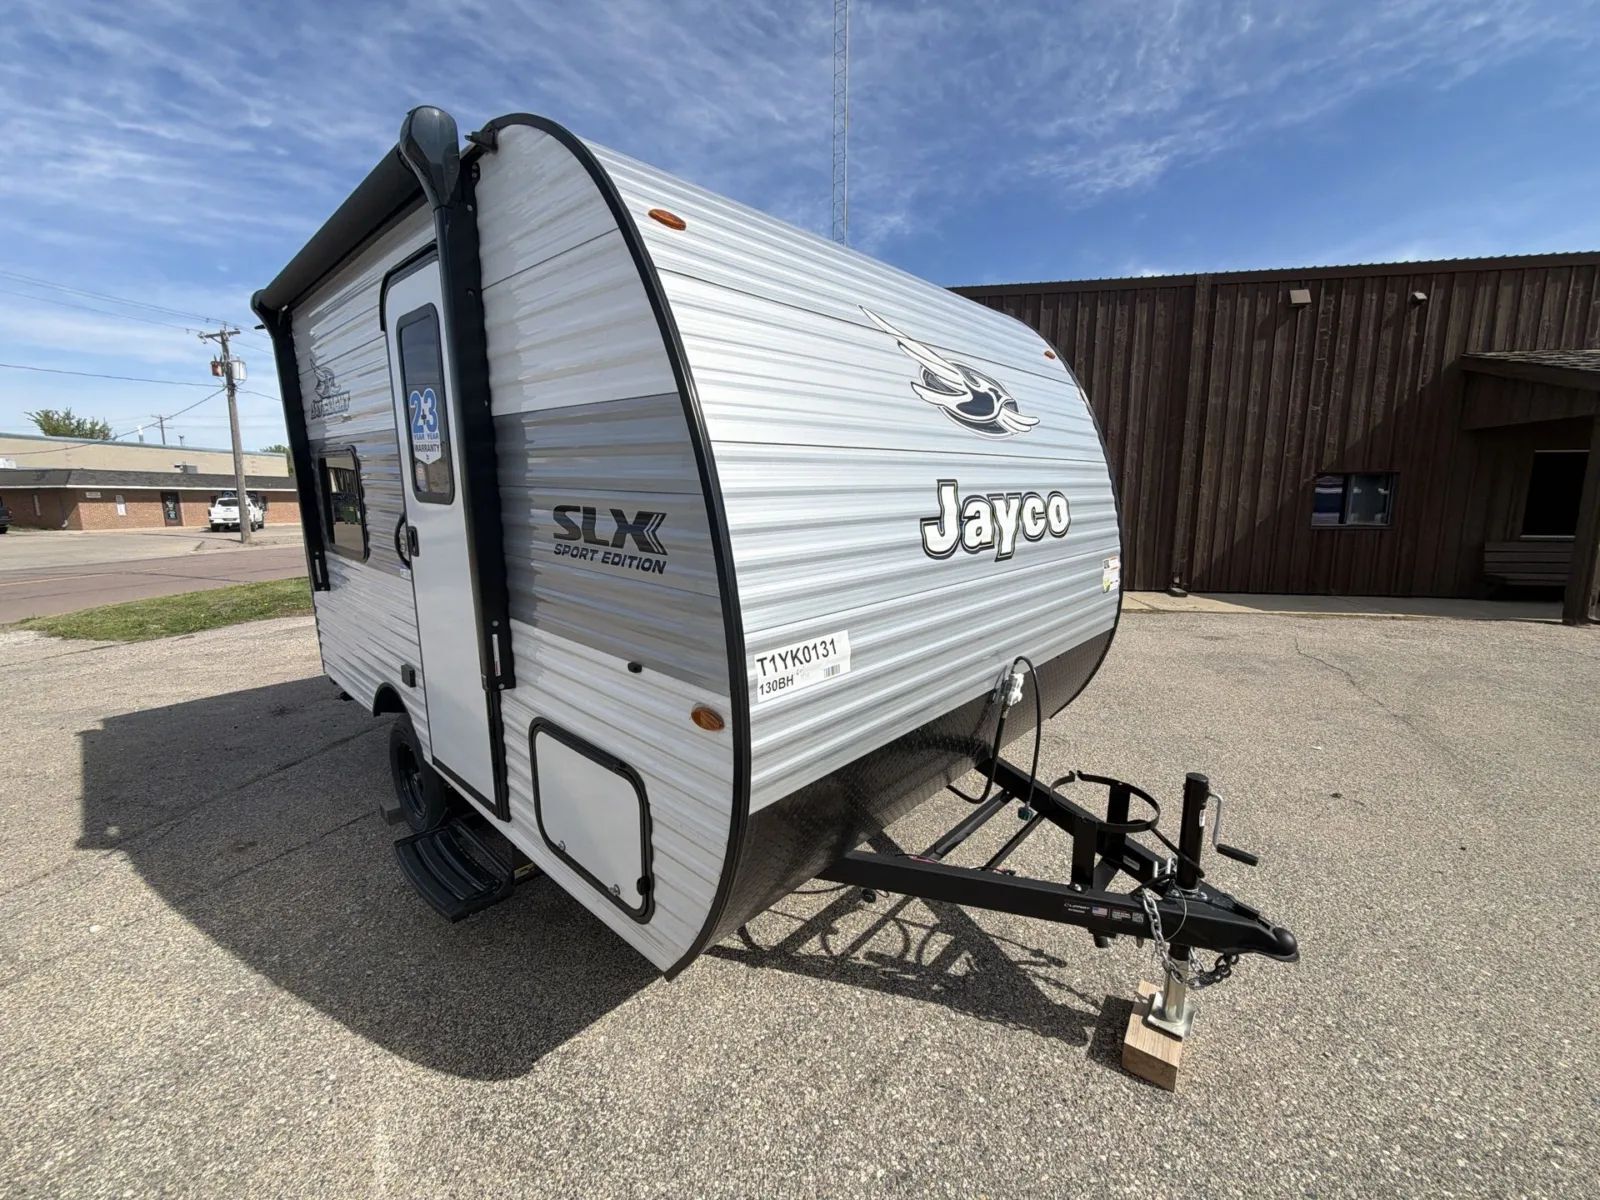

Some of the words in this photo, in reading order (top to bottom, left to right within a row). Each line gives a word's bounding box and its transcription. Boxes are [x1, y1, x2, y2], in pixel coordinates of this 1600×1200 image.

[415, 444, 440, 453] WARRANTY
[553, 504, 668, 556] SLX
[920, 478, 1072, 562] Jayco
[553, 543, 599, 562] SPORT
[601, 551, 667, 575] EDITION
[756, 637, 837, 676] T1YK0131
[759, 674, 794, 695] 130BH
